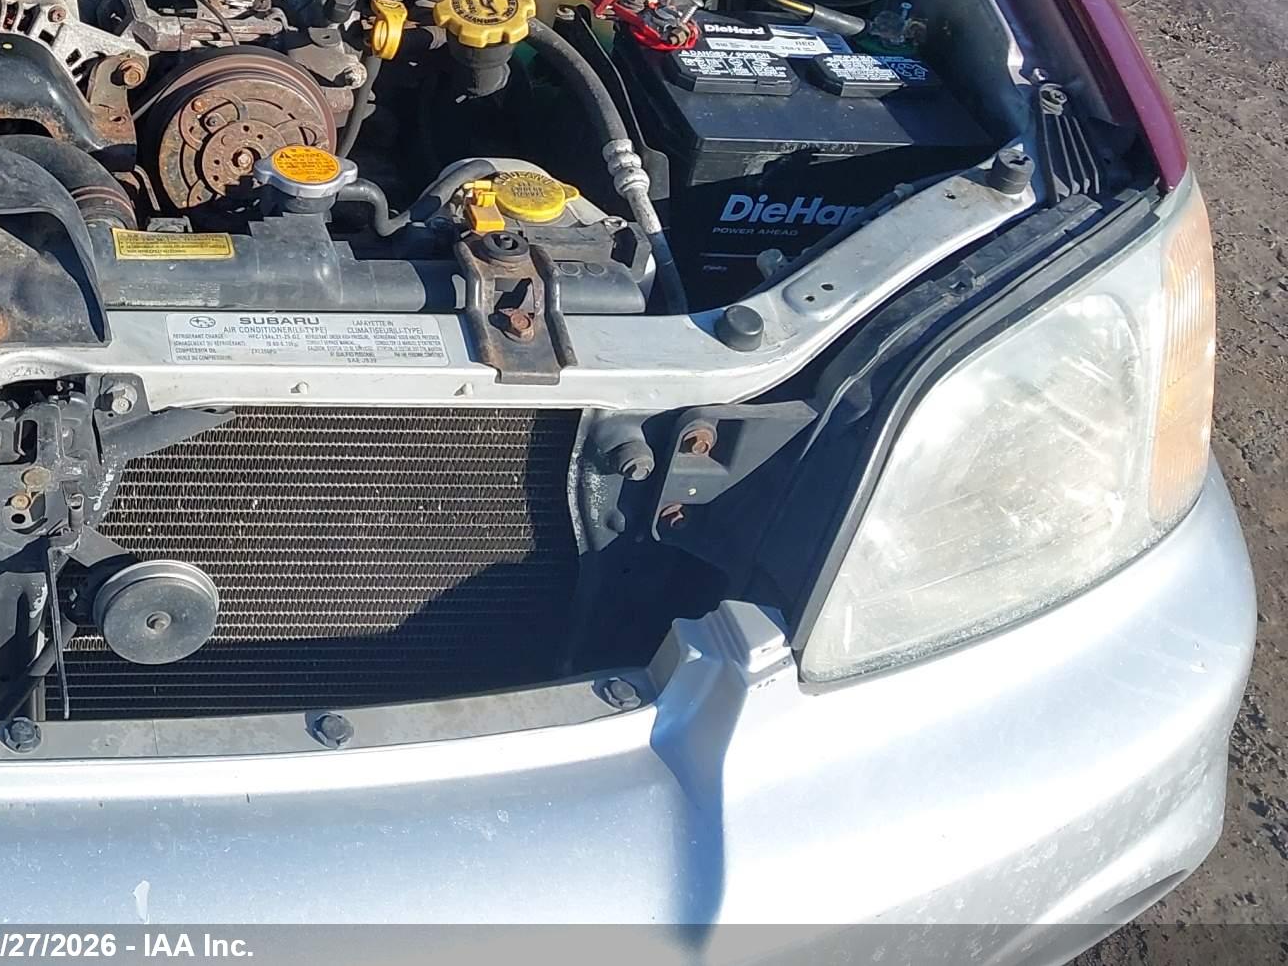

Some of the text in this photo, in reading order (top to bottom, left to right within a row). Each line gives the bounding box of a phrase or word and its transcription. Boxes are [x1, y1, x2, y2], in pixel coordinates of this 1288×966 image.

[704, 24, 765, 34] DieHard
[689, 50, 724, 58] DANGER
[720, 194, 865, 225] DieHar
[712, 227, 798, 236] POWER AHEAD
[239, 316, 320, 325] SUBARU
